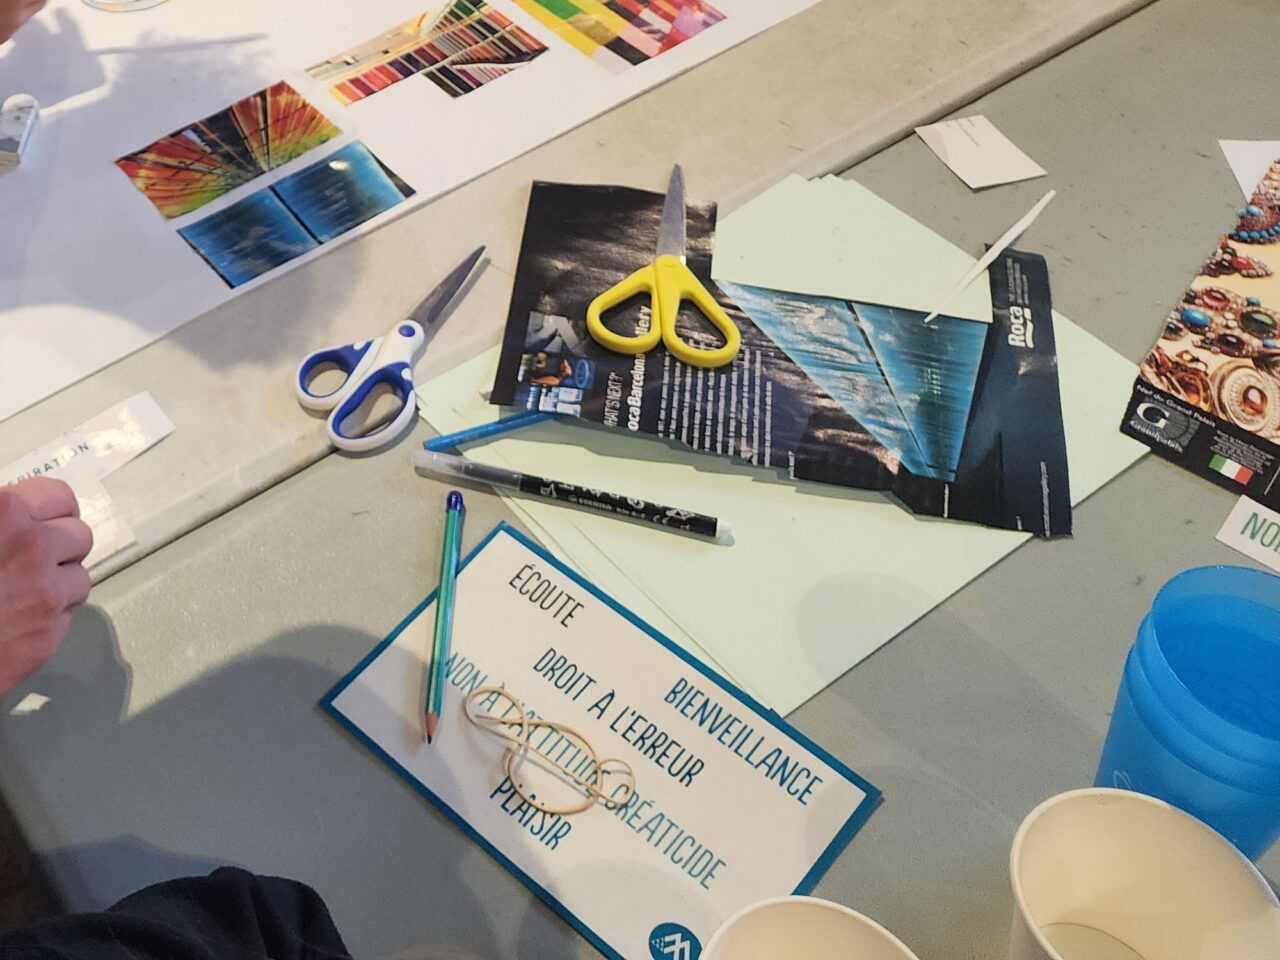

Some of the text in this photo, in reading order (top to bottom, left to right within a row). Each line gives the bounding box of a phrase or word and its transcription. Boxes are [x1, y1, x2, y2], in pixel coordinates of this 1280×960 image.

[1008, 305, 1025, 348] Roca
[627, 406, 641, 431] oca
[1166, 398, 1193, 416] Grand
[1240, 512, 1280, 552] NO
[508, 563, 585, 629] ÉCOUTE
[533, 647, 706, 788] DROIT À L'ERREUR
[664, 677, 824, 806] BIENVEILLANCE
[445, 652, 489, 692] NON
[604, 783, 727, 890] CRÉATICIDE
